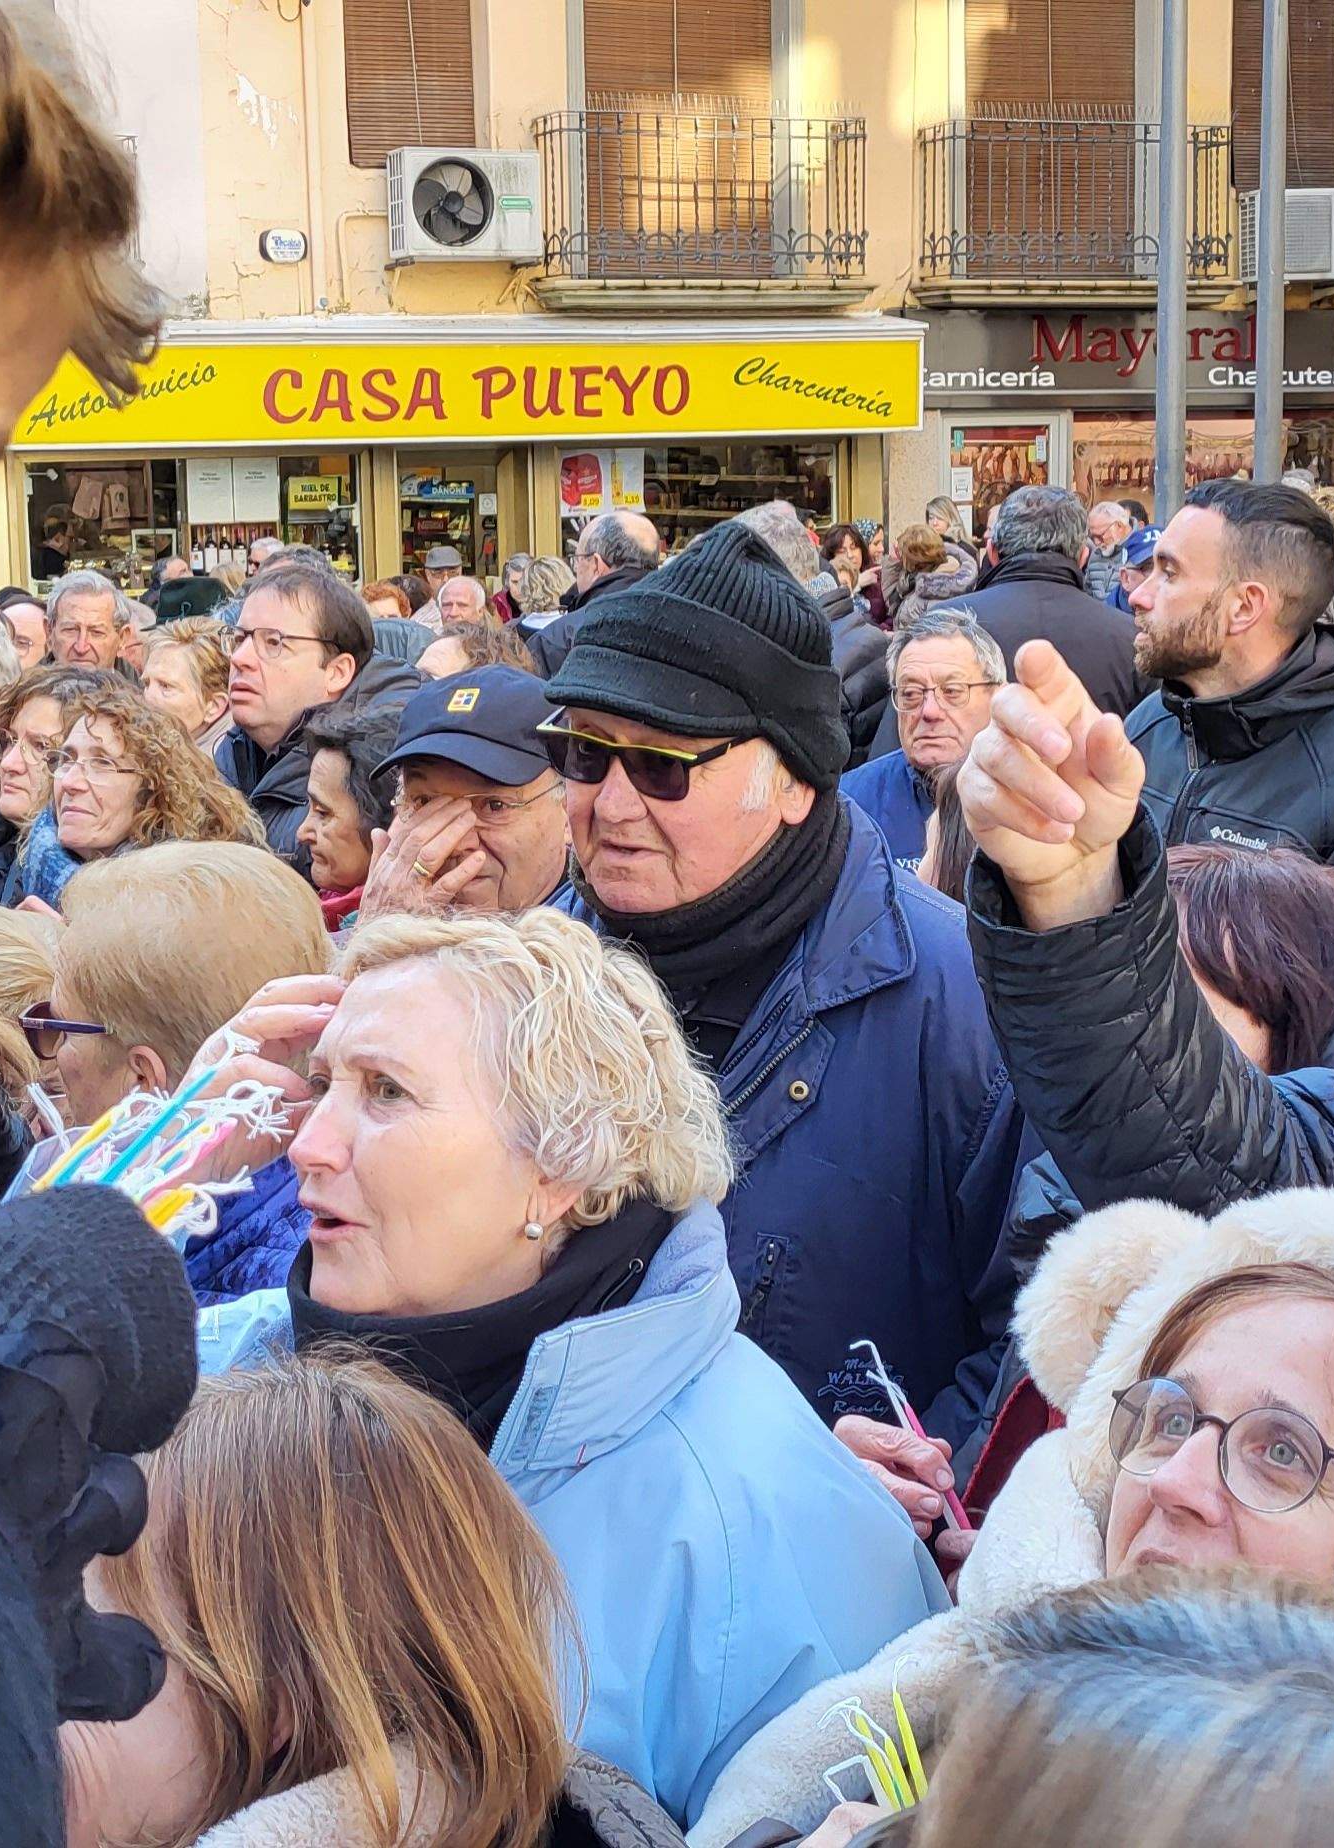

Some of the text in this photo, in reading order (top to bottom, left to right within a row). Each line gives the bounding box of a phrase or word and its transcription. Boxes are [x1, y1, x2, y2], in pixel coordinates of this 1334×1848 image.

[1029, 313, 1257, 377] Mayral
[263, 364, 690, 424] CASA PUEYO
[733, 356, 894, 417] Charcutería
[293, 493, 337, 503] BARBASTRO
